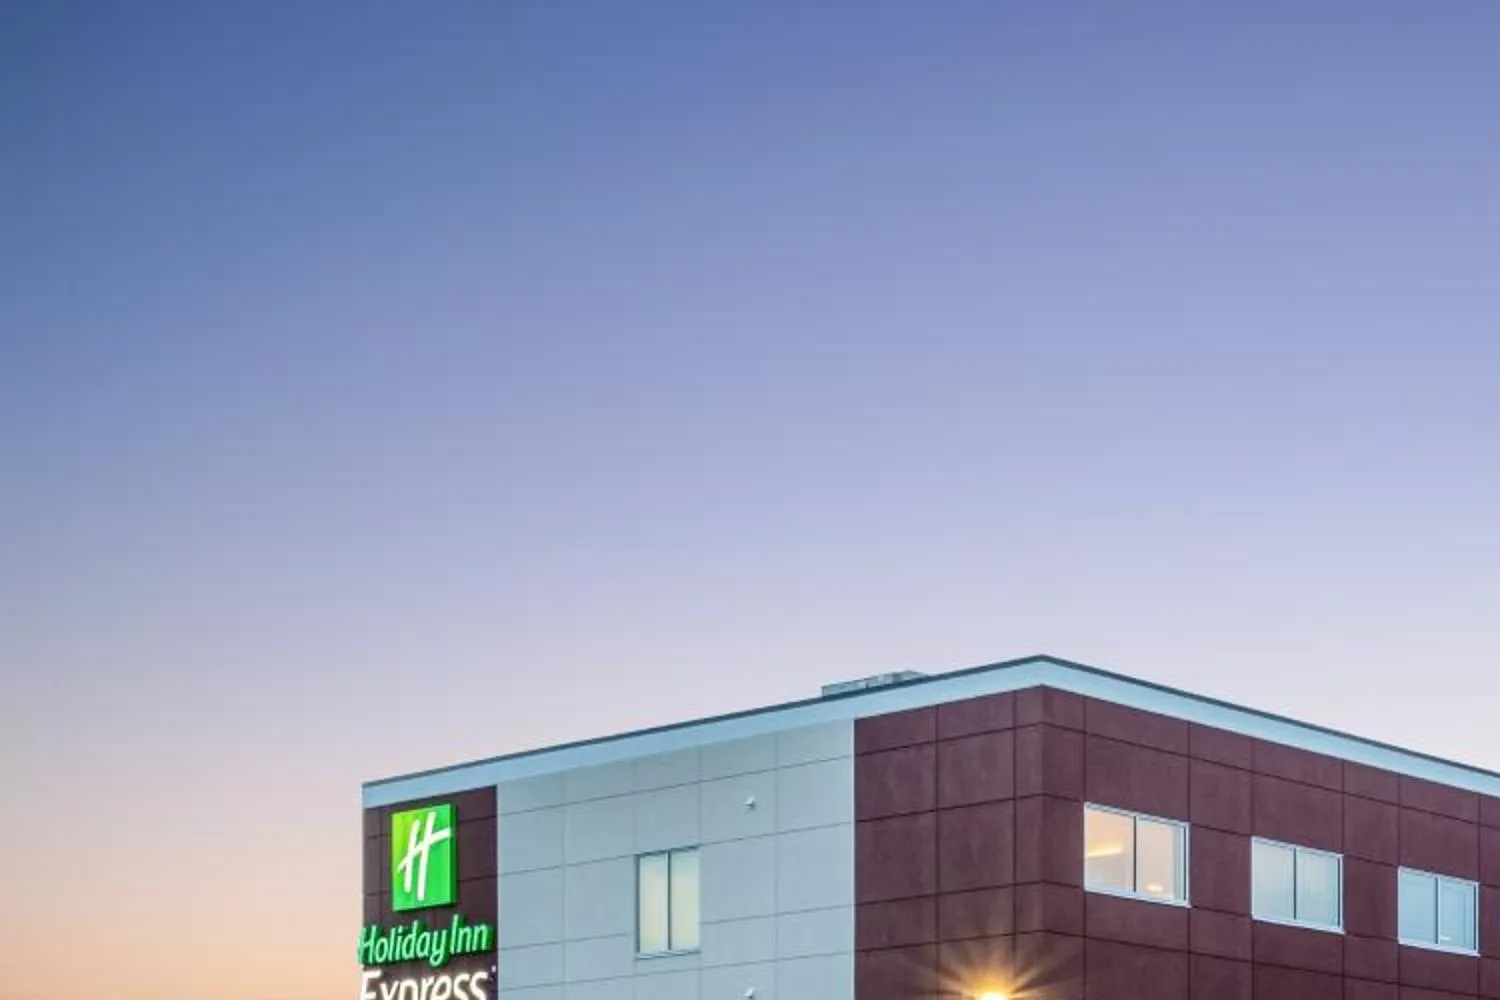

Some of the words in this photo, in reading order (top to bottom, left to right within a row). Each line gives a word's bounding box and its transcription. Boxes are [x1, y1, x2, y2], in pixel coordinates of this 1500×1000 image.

[397, 811, 452, 900] H
[357, 919, 448, 966] Holiday
[450, 914, 491, 954] Inn
